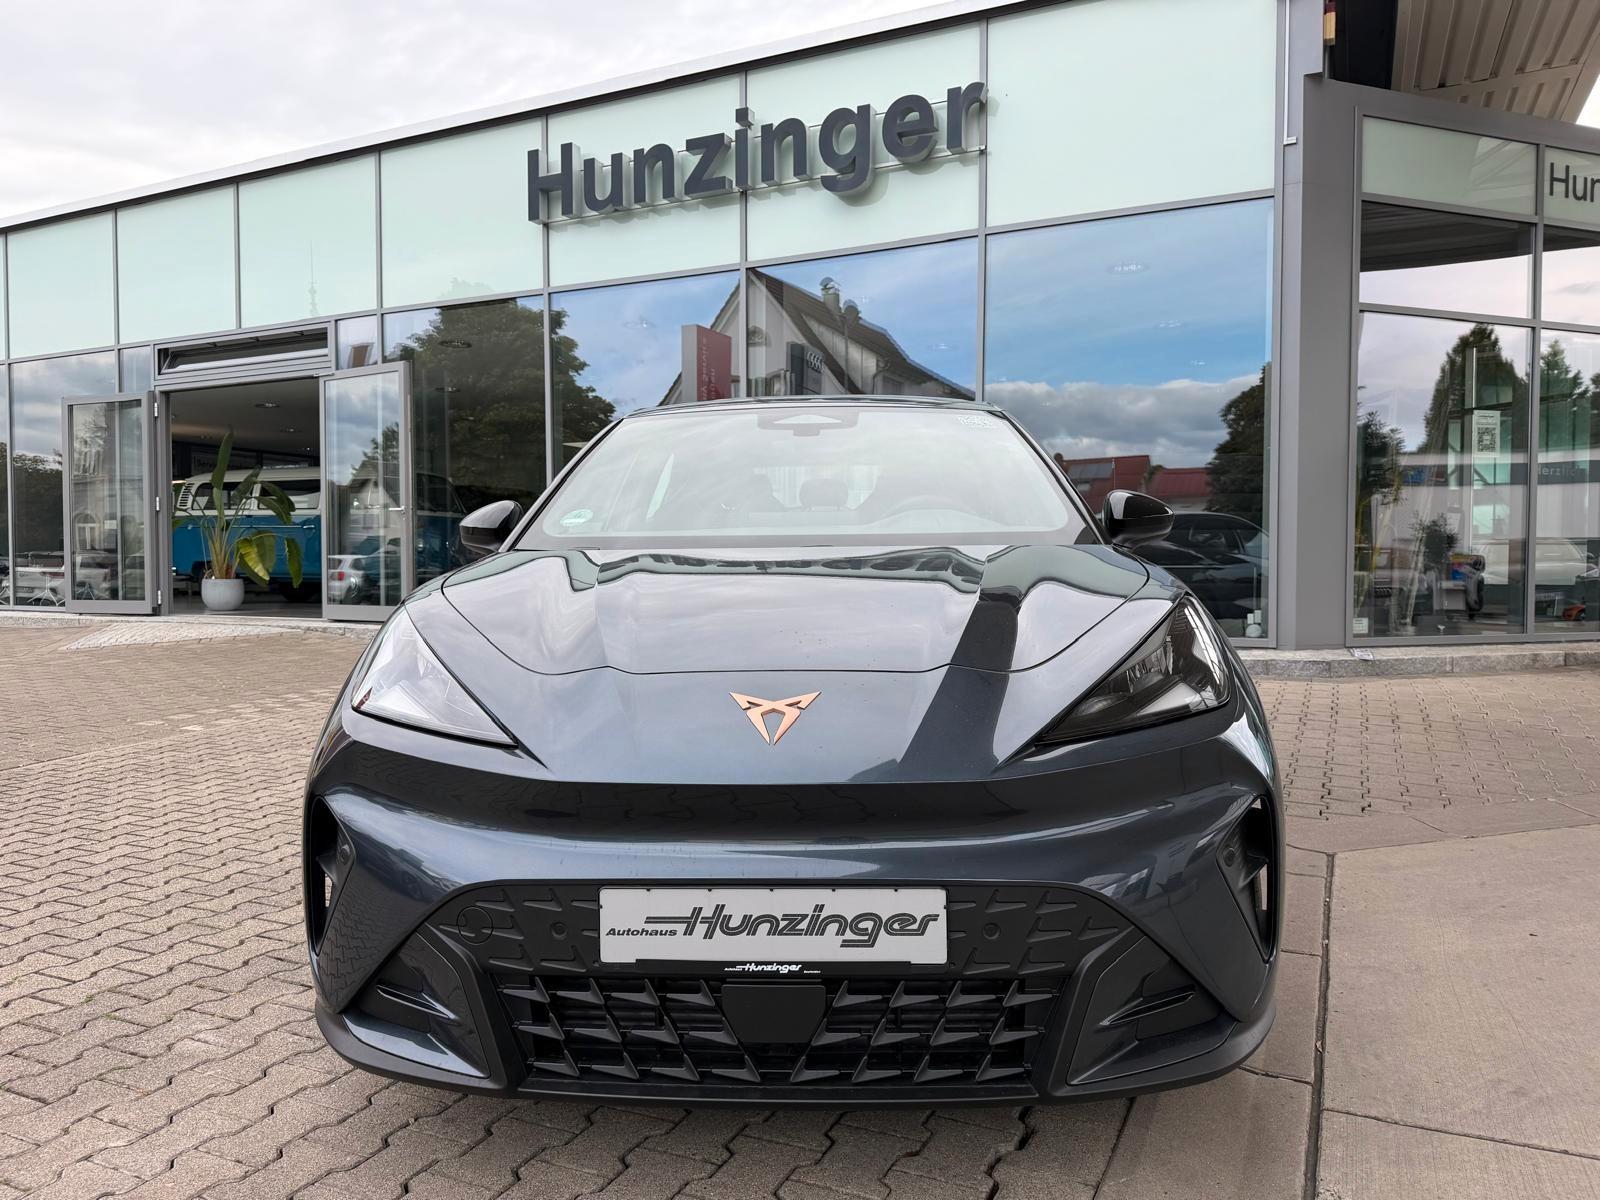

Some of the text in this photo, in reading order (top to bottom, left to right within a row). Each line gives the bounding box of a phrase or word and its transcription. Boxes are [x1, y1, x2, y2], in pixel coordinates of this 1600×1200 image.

[528, 82, 987, 224] Hunzinger
[605, 904, 939, 948] Autohaus Hunzinger
[736, 963, 802, 974] Hunzinger
